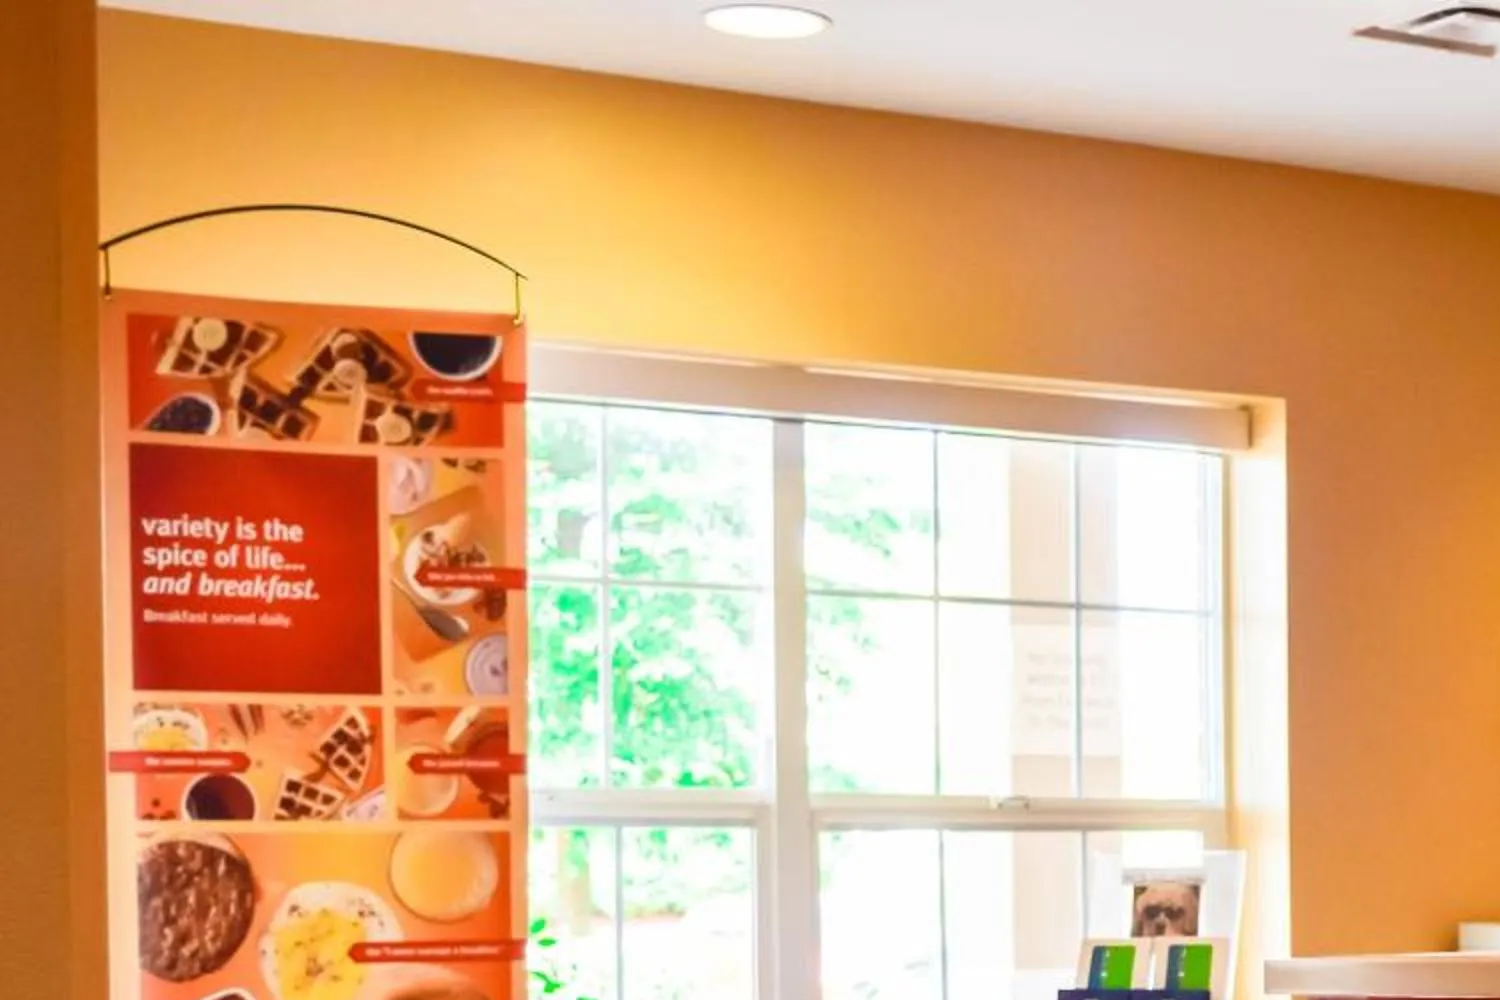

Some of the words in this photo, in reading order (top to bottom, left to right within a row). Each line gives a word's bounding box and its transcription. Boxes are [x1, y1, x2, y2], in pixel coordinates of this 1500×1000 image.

[142, 513, 230, 544] variety
[235, 516, 257, 541] is
[263, 517, 304, 543] the
[142, 542, 208, 571] spice
[214, 544, 240, 569] of
[245, 545, 307, 572] life...
[143, 572, 192, 596] and
[198, 572, 320, 604] breakfast.
[143, 609, 208, 625] Breakfast
[211, 612, 257, 625] served
